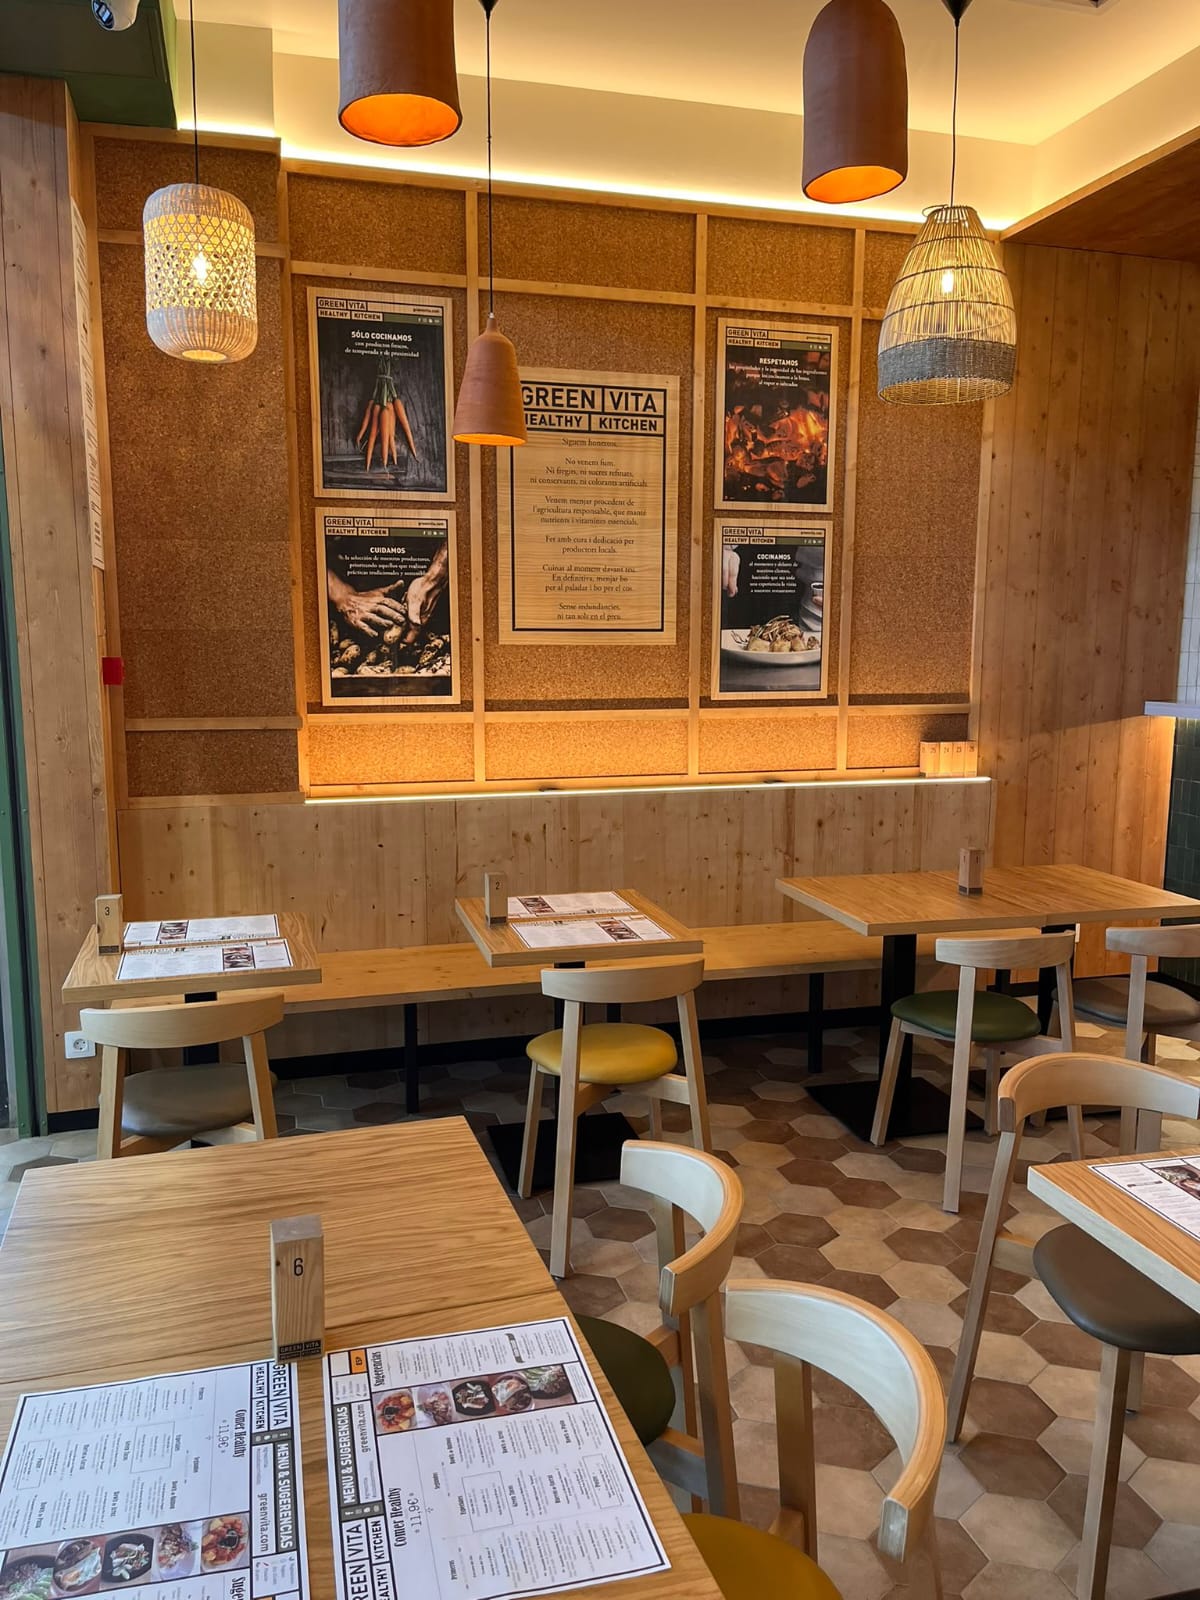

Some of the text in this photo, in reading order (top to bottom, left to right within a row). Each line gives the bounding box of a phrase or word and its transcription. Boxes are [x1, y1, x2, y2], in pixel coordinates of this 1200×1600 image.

[320, 300, 365, 310] GREEN VITA
[320, 310, 348, 318] HEALTHY
[351, 330, 412, 342] SÓLO COCINAMOS
[759, 358, 798, 366] RESPETAMOS
[522, 386, 657, 413] GREEN VITA
[599, 417, 657, 431] KITCHEN
[545, 466, 555, 474] Ni
[545, 496, 567, 504] Venem
[573, 507, 612, 516] responsable,
[326, 518, 352, 526] GREEN
[624, 538, 634, 546] per
[552, 573, 561, 581] En
[604, 585, 613, 593] per
[495, 881, 500, 890] 2
[104, 906, 110, 916] 3
[293, 1257, 304, 1276] 6
[256, 1367, 265, 1430] HEALTHY KITCHEN
[272, 1364, 288, 1426] GREEN VITA
[232, 1408, 247, 1458] Comer Healthy
[354, 1403, 370, 1453] greenvita.com
[336, 1405, 352, 1465] SUGERENCIAS
[340, 1465, 353, 1474] &
[341, 1474, 355, 1503] MENU
[276, 1443, 293, 1549] MENU & SUGERENCIAS
[257, 1492, 270, 1552] greenvita.com
[386, 1486, 407, 1547] Comer Healthy
[345, 1523, 369, 1600] REEN VITA
[370, 1519, 390, 1597] ALTHY KITCHEN
